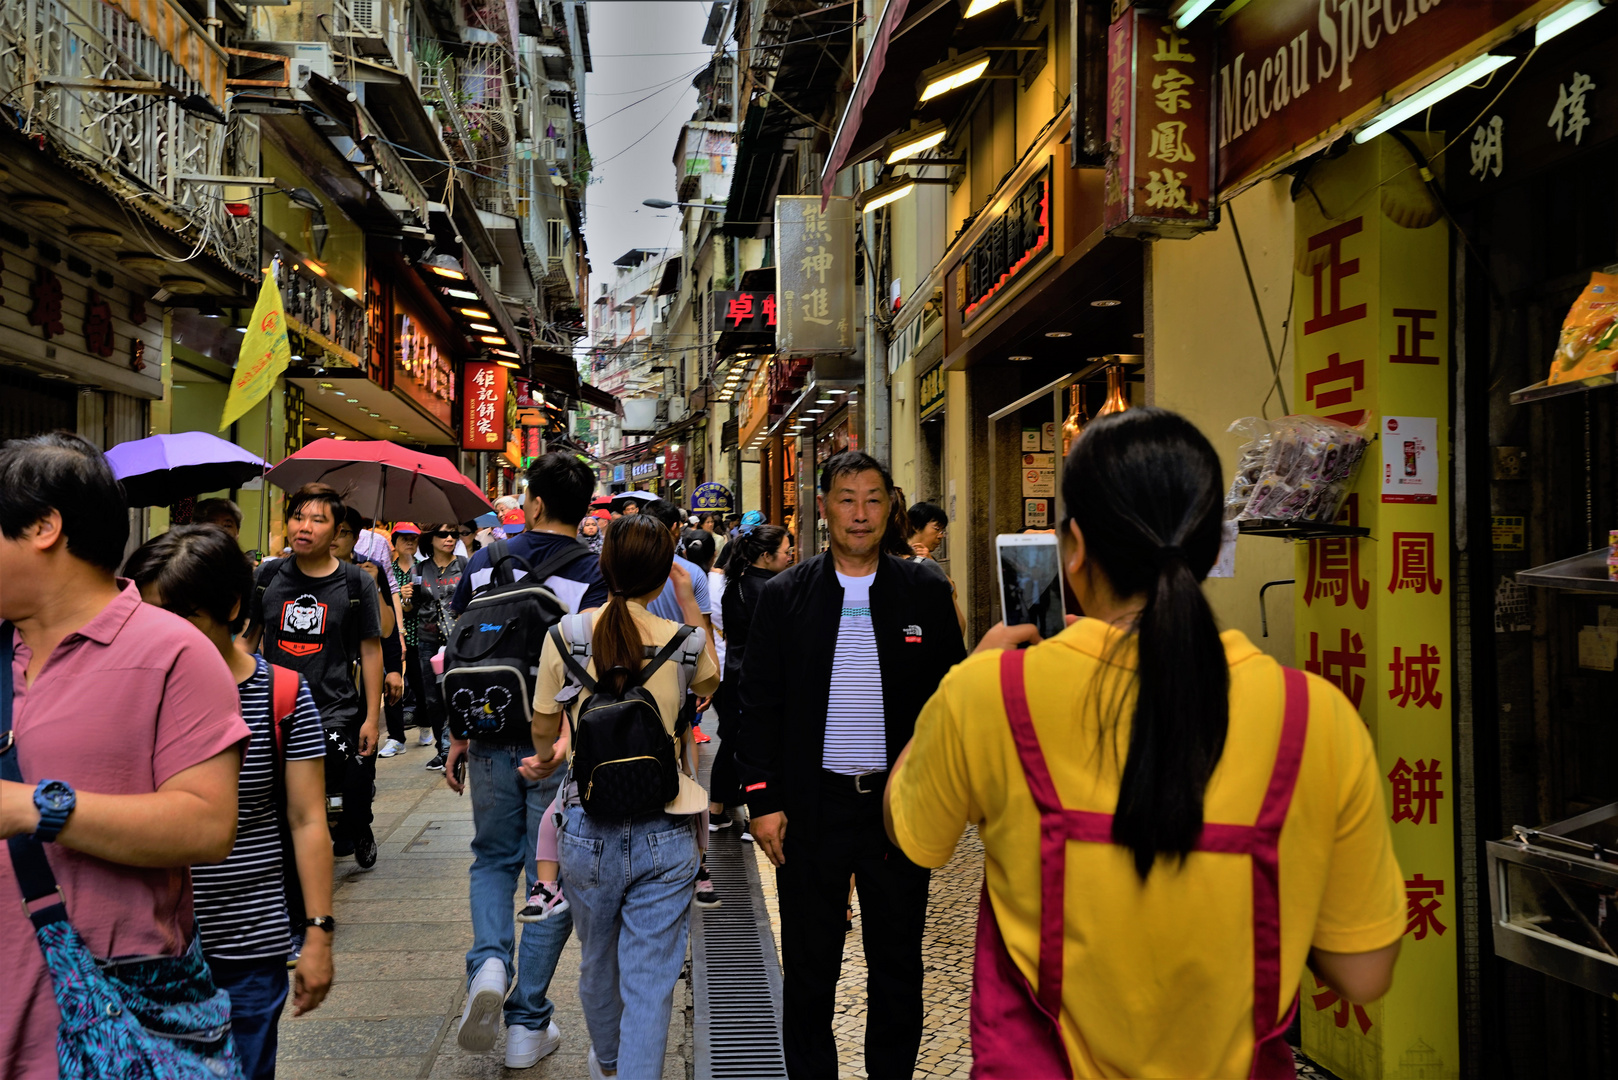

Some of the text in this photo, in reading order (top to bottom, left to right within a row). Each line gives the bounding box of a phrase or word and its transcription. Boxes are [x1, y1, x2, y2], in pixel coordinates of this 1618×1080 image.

[1145, 25, 1199, 215] 正宗鳳城
[1219, 30, 1310, 149] Macau
[800, 204, 834, 325] 熊神進
[473, 368, 498, 434] 鉅記餅家
[1387, 307, 1448, 941] 正鳳城餅家
